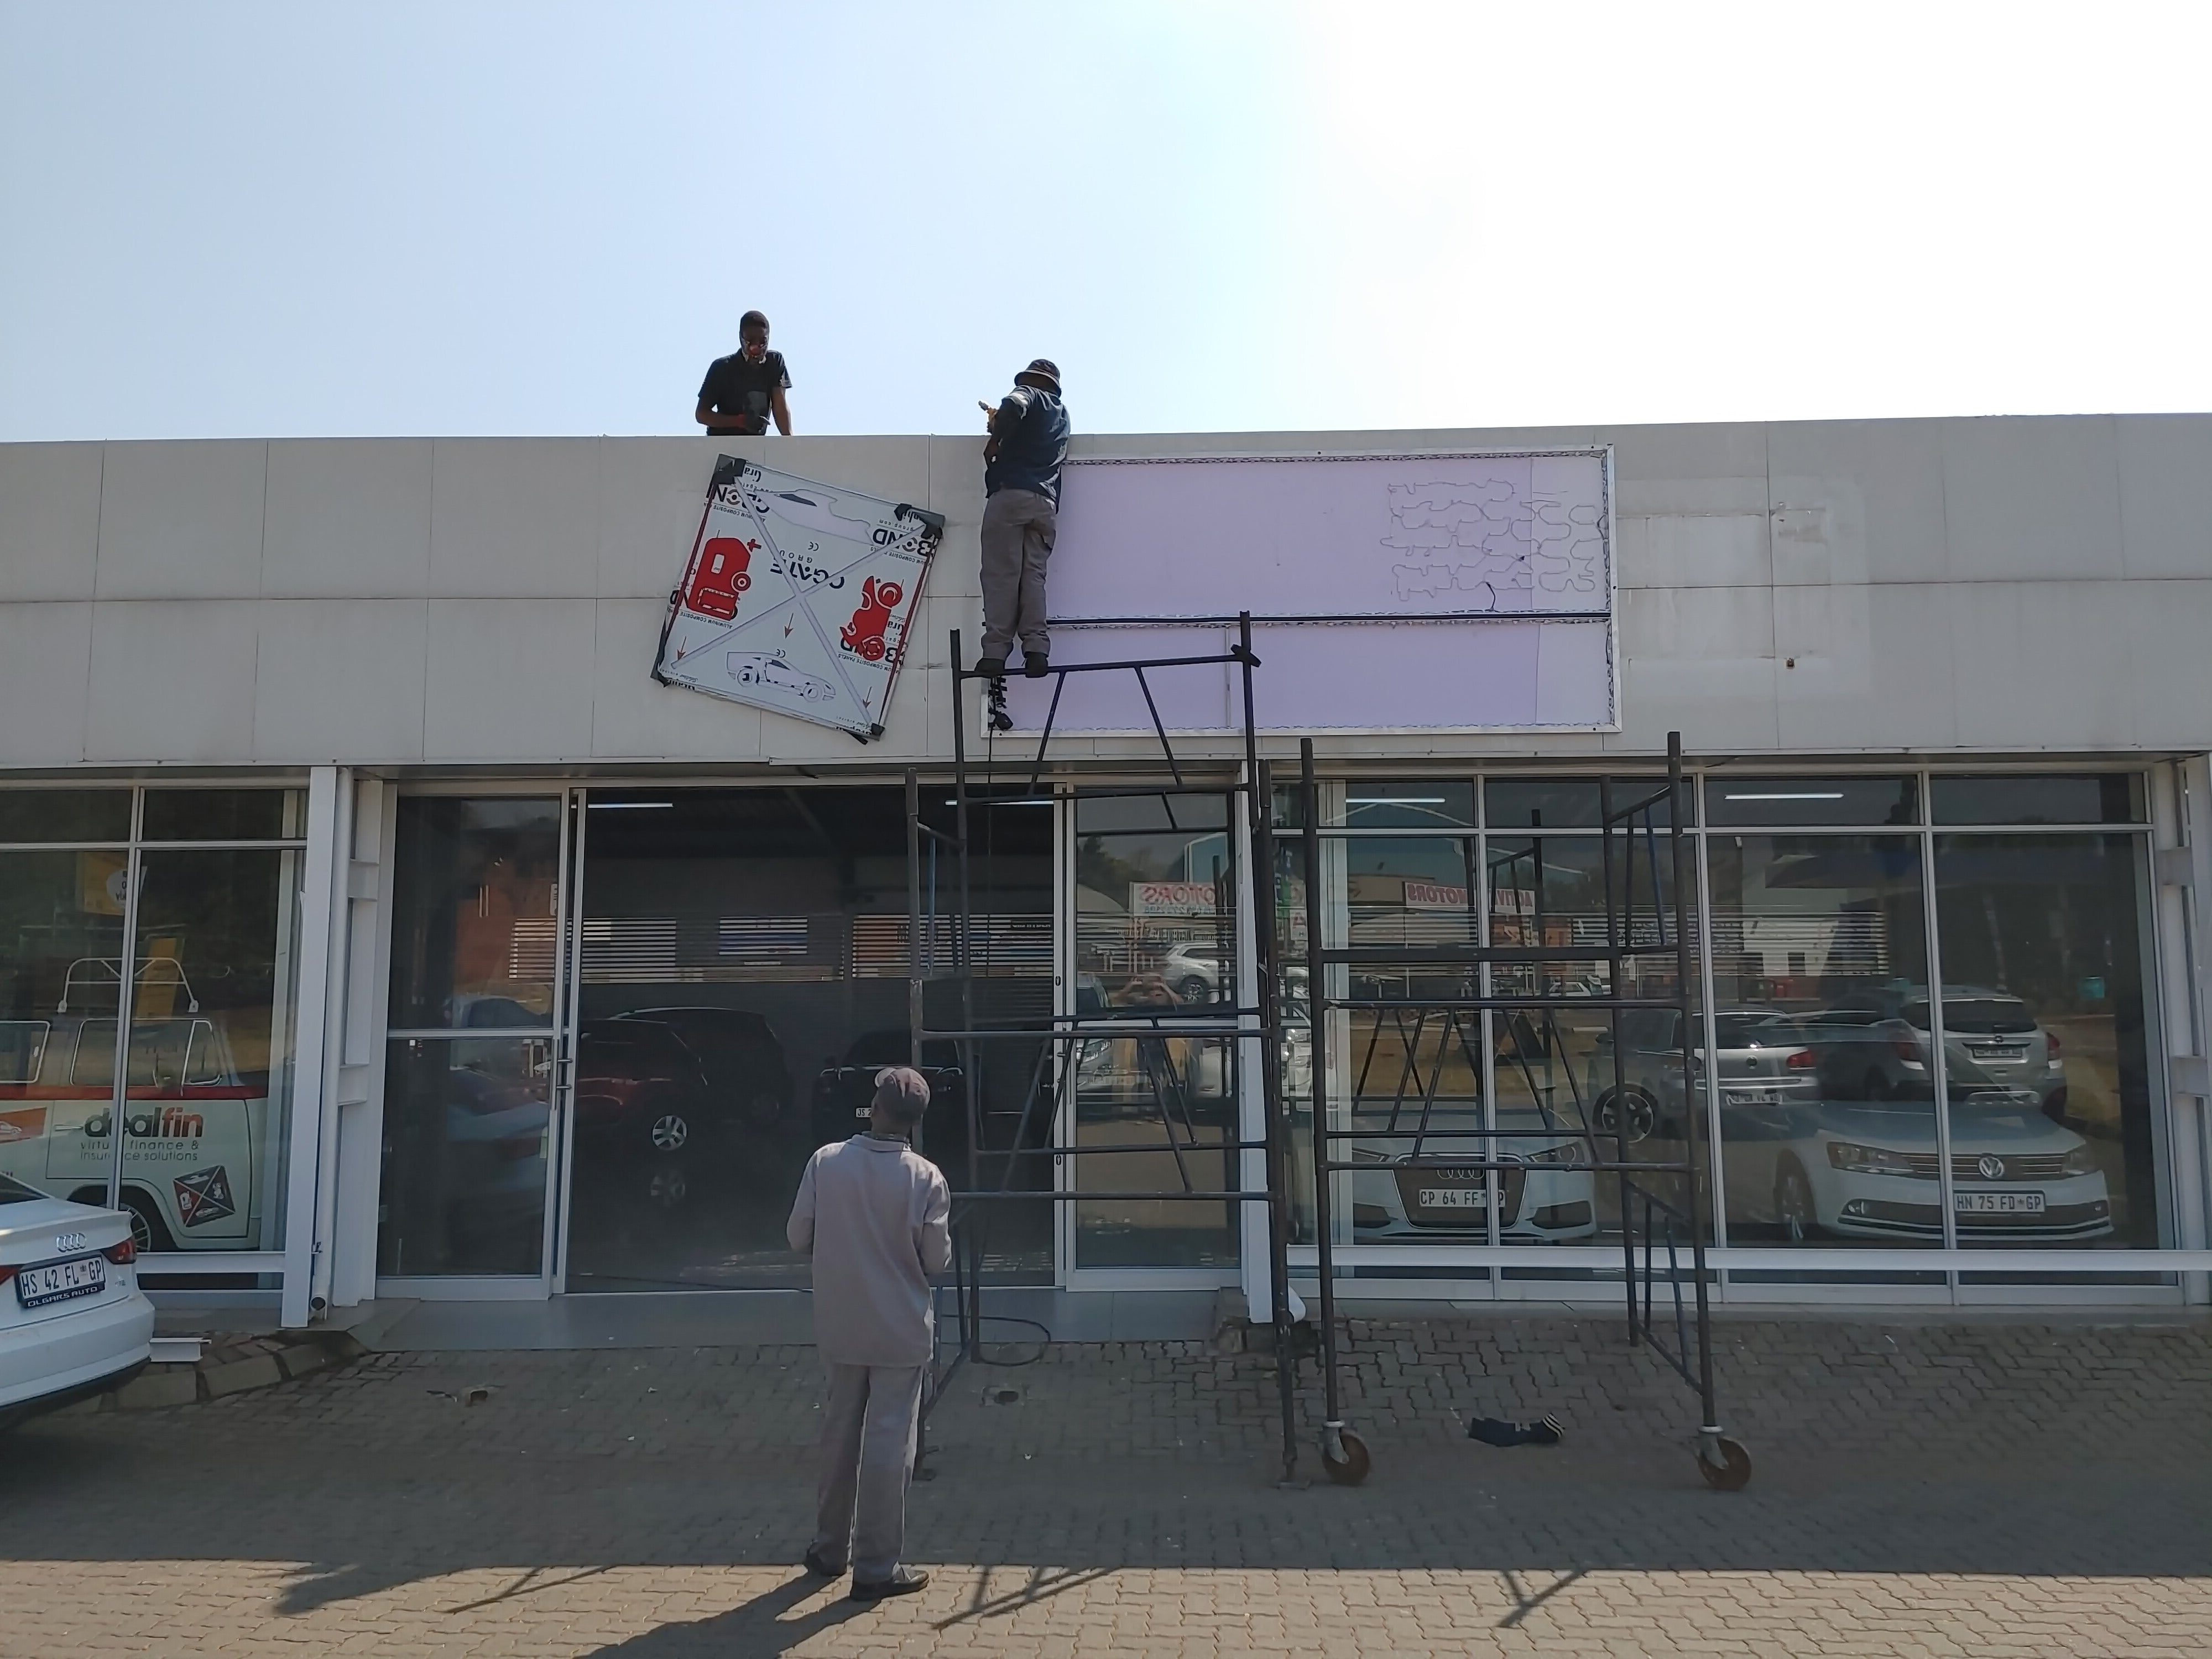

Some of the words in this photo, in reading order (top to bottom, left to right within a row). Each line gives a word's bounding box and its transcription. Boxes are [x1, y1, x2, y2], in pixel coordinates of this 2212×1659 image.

[713, 504, 739, 515] COMPOSITE
[779, 549, 812, 564] GROU
[888, 551, 915, 562] COMPOSITE
[680, 611, 706, 622] COMPOSITE
[707, 619, 732, 629] ALUMINUM
[837, 653, 855, 662] PANELS
[856, 658, 883, 669] COMPOSITE
[81, 1140, 109, 1150] virtu
[131, 1140, 184, 1150] finance
[191, 1140, 199, 1150] &
[81, 1152, 140, 1160] insurce
[144, 1151, 197, 1161] solutions
[1420, 1191, 1435, 1205] CP
[1442, 1191, 1457, 1205] 64
[1464, 1192, 1479, 1205] FF
[1957, 1196, 1973, 1209] HN
[1978, 1196, 1994, 1209] 75
[2000, 1196, 2015, 1209] FD
[2026, 1196, 2041, 1210] GP
[21, 1273, 38, 1296] HS
[45, 1269, 60, 1290] 42
[65, 1265, 80, 1286] FL
[88, 1259, 102, 1281] GP
[71, 1286, 98, 1297] AUTO
